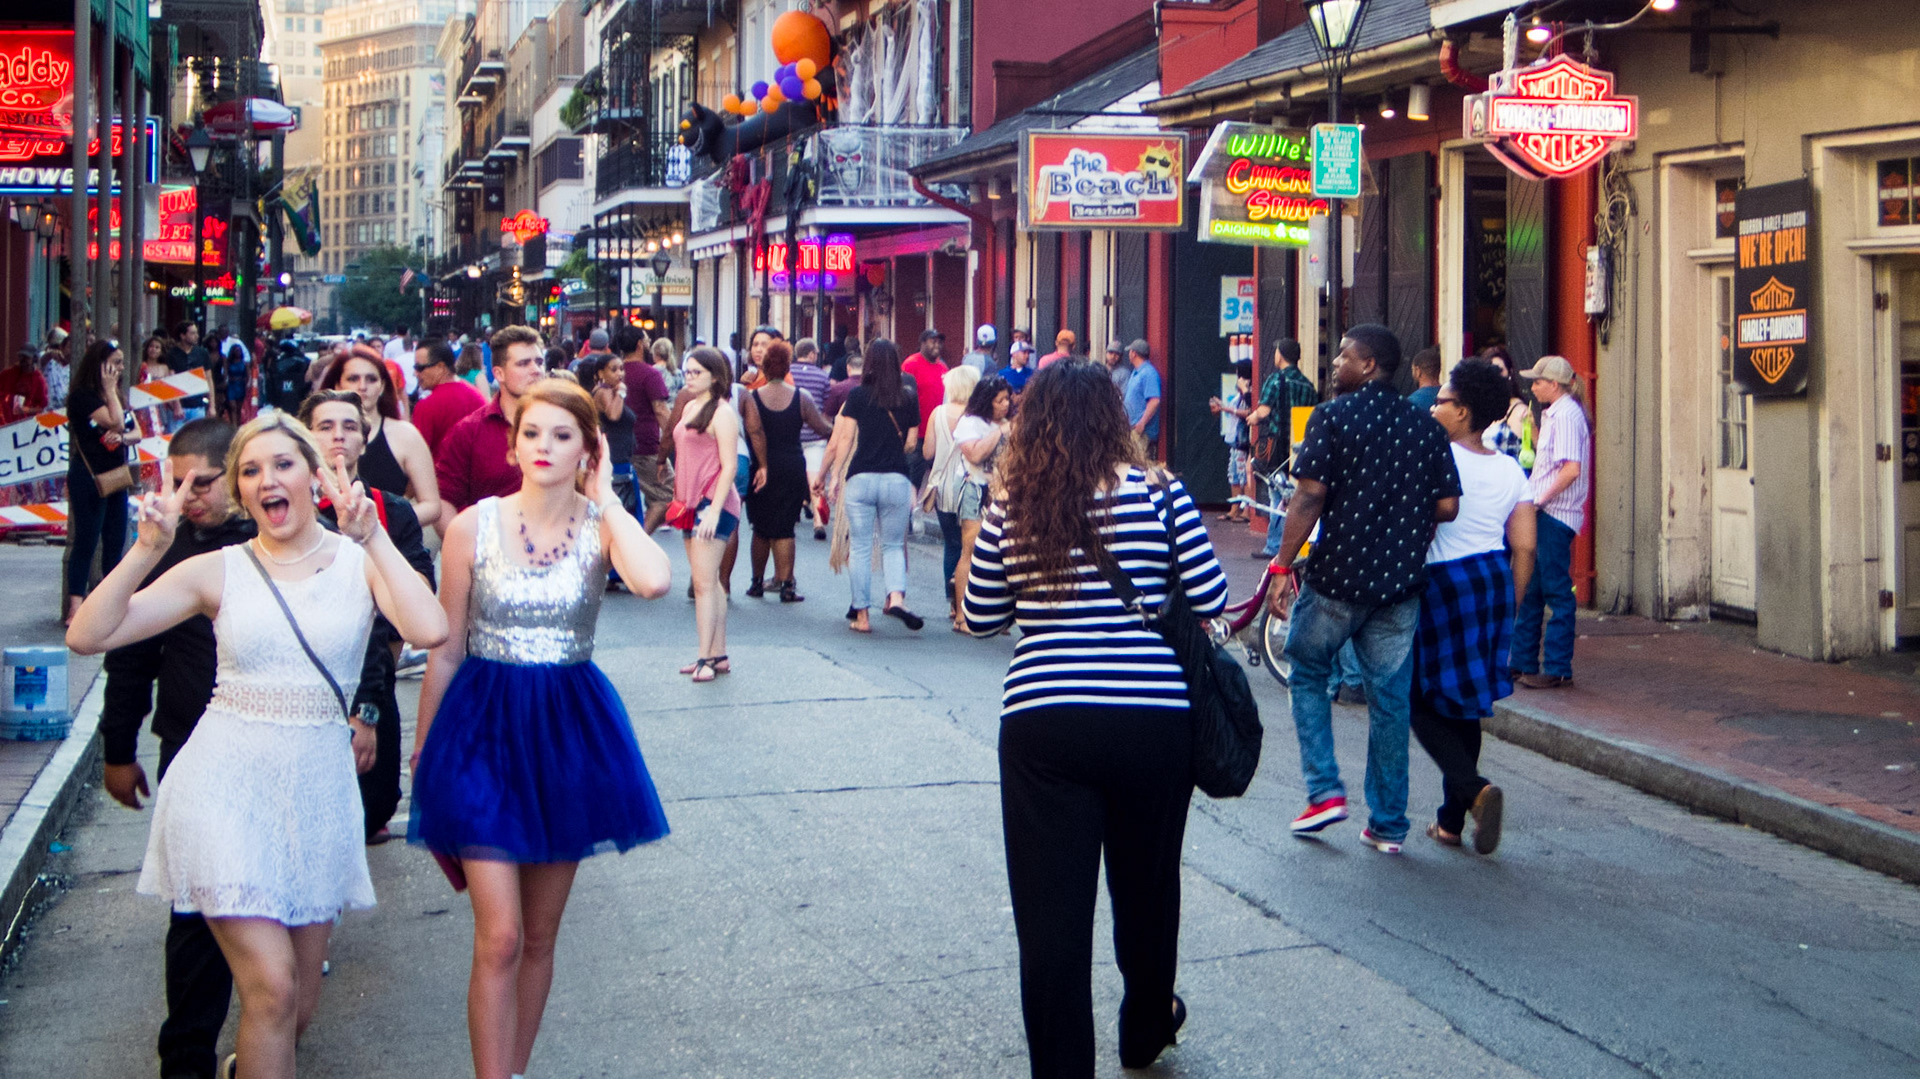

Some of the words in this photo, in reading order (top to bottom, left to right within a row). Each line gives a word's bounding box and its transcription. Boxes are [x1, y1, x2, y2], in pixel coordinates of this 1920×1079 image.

[1529, 71, 1596, 100] MOTOR
[33, 112, 71, 126] TEES
[1498, 104, 1626, 131] HARLEY-DAVIDSON
[1528, 135, 1594, 166] CYCLES
[1070, 154, 1101, 177] the
[1227, 158, 1312, 193] CHICK
[1050, 170, 1172, 197] Beach
[1247, 189, 1330, 221] SHAC
[501, 217, 523, 231] Hard
[525, 218, 547, 233] Rock
[1214, 223, 1271, 238] DAIQUIRIS
[1275, 222, 1287, 238] &
[1739, 217, 1762, 236] BOURBON
[1764, 210, 1806, 232] HARLEY-DAVIDSON
[756, 244, 853, 271] UTLER
[1739, 232, 1772, 268] WE'RE
[1775, 226, 1806, 264] OPEN!
[171, 286, 195, 296] OYST
[205, 286, 224, 297] BAR
[773, 273, 834, 286] CUB
[1756, 284, 1789, 312] MOTOR
[1741, 314, 1804, 343] HARLEY-DAVIDSON
[1756, 347, 1789, 377] CYCLES
